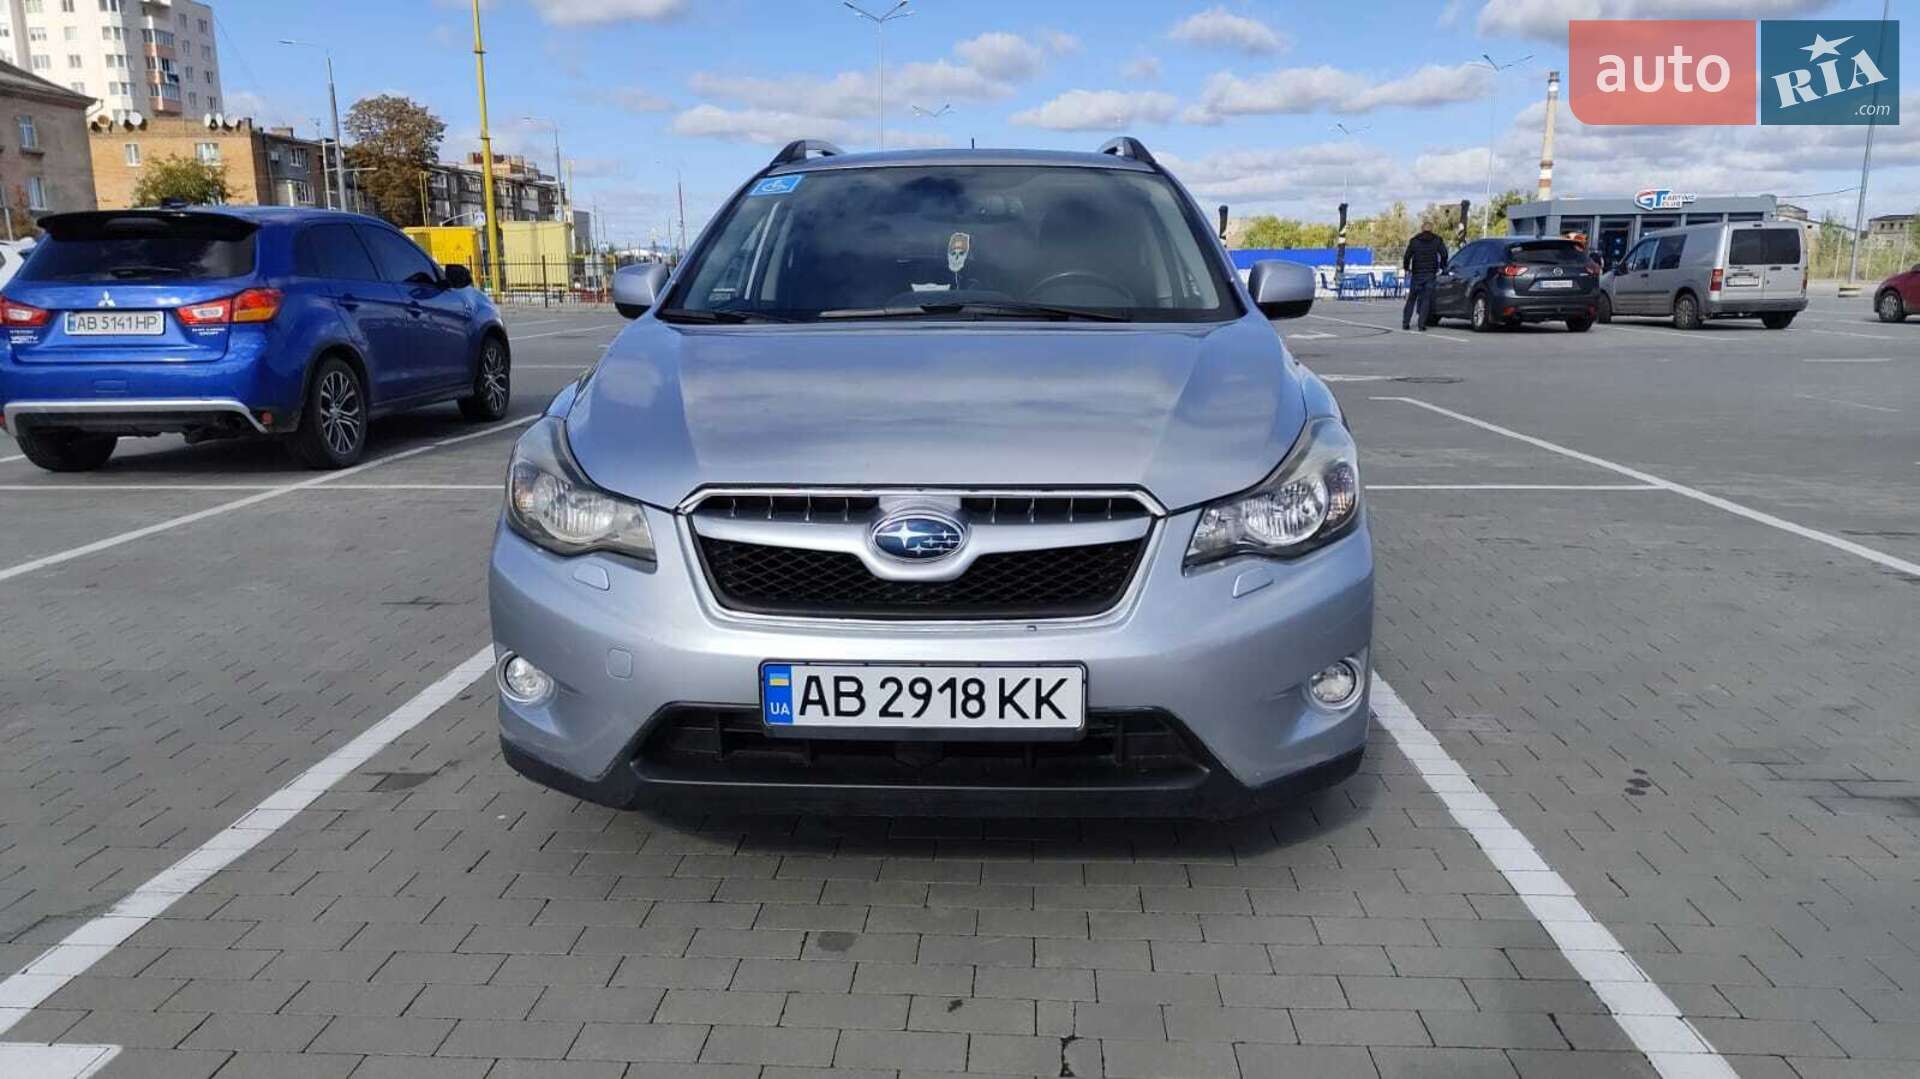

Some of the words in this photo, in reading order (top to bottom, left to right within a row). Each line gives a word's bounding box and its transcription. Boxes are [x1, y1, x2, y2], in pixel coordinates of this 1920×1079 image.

[77, 316, 97, 330] AB
[102, 316, 133, 331] 5141
[135, 316, 158, 330] HP
[799, 675, 866, 718] AB
[878, 676, 987, 719] 2918
[998, 677, 1068, 720] KK
[770, 703, 790, 716] UA
